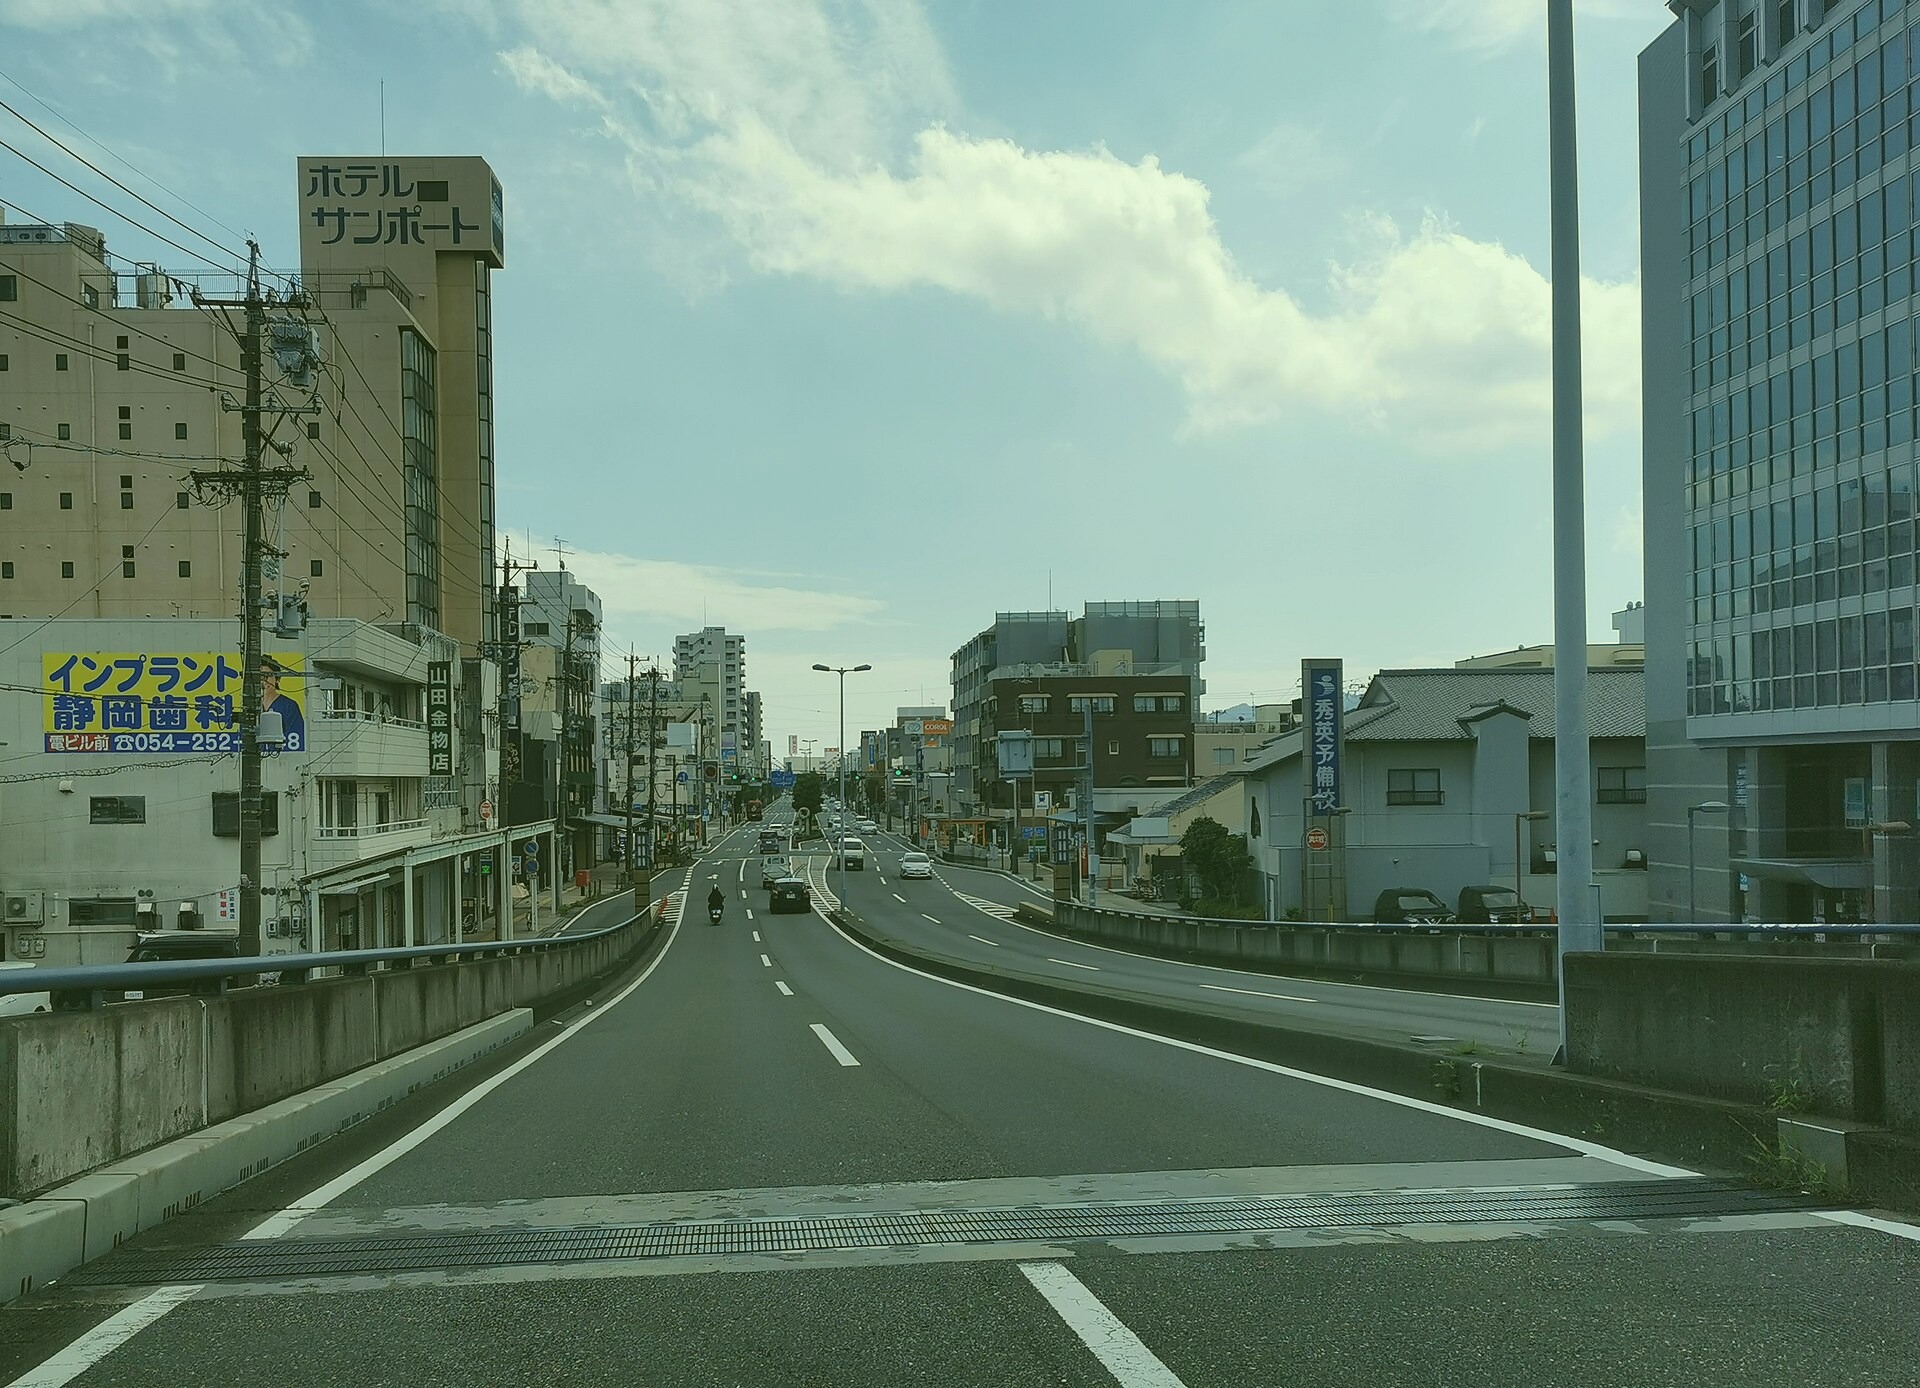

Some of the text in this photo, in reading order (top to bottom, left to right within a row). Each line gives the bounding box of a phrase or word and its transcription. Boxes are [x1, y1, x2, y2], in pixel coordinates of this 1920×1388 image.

[307, 165, 414, 197] ホテル
[311, 205, 479, 244] サンポート
[49, 654, 239, 692] インプラント
[53, 694, 234, 731] 静岡歯科
[430, 667, 449, 772] 山田金物店
[49, 734, 109, 751] 電ビル前
[1314, 699, 1336, 811] 秀英予備校
